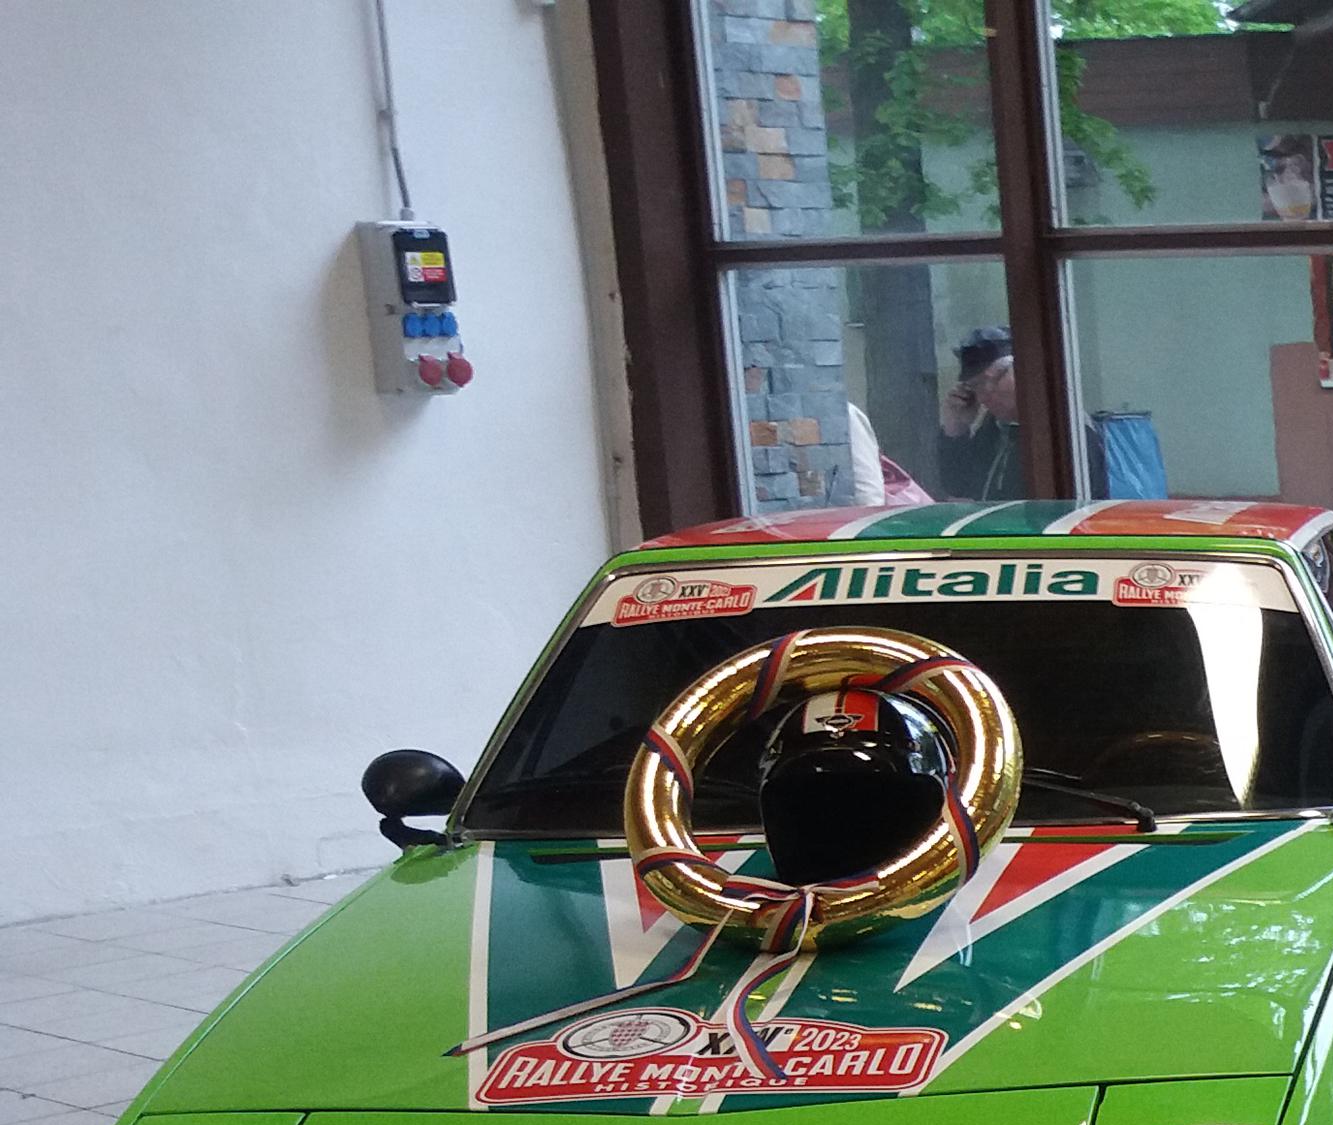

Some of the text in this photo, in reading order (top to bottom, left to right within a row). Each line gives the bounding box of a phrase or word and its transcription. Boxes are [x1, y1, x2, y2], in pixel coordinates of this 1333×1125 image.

[763, 563, 1100, 602] Alitalia
[1118, 583, 1161, 600] RALLYE
[619, 602, 660, 619] RALLYE
[794, 1027, 862, 1051] 2023
[499, 1056, 631, 1088] RALLYE
[594, 1077, 808, 1092] HISTORIQUE
